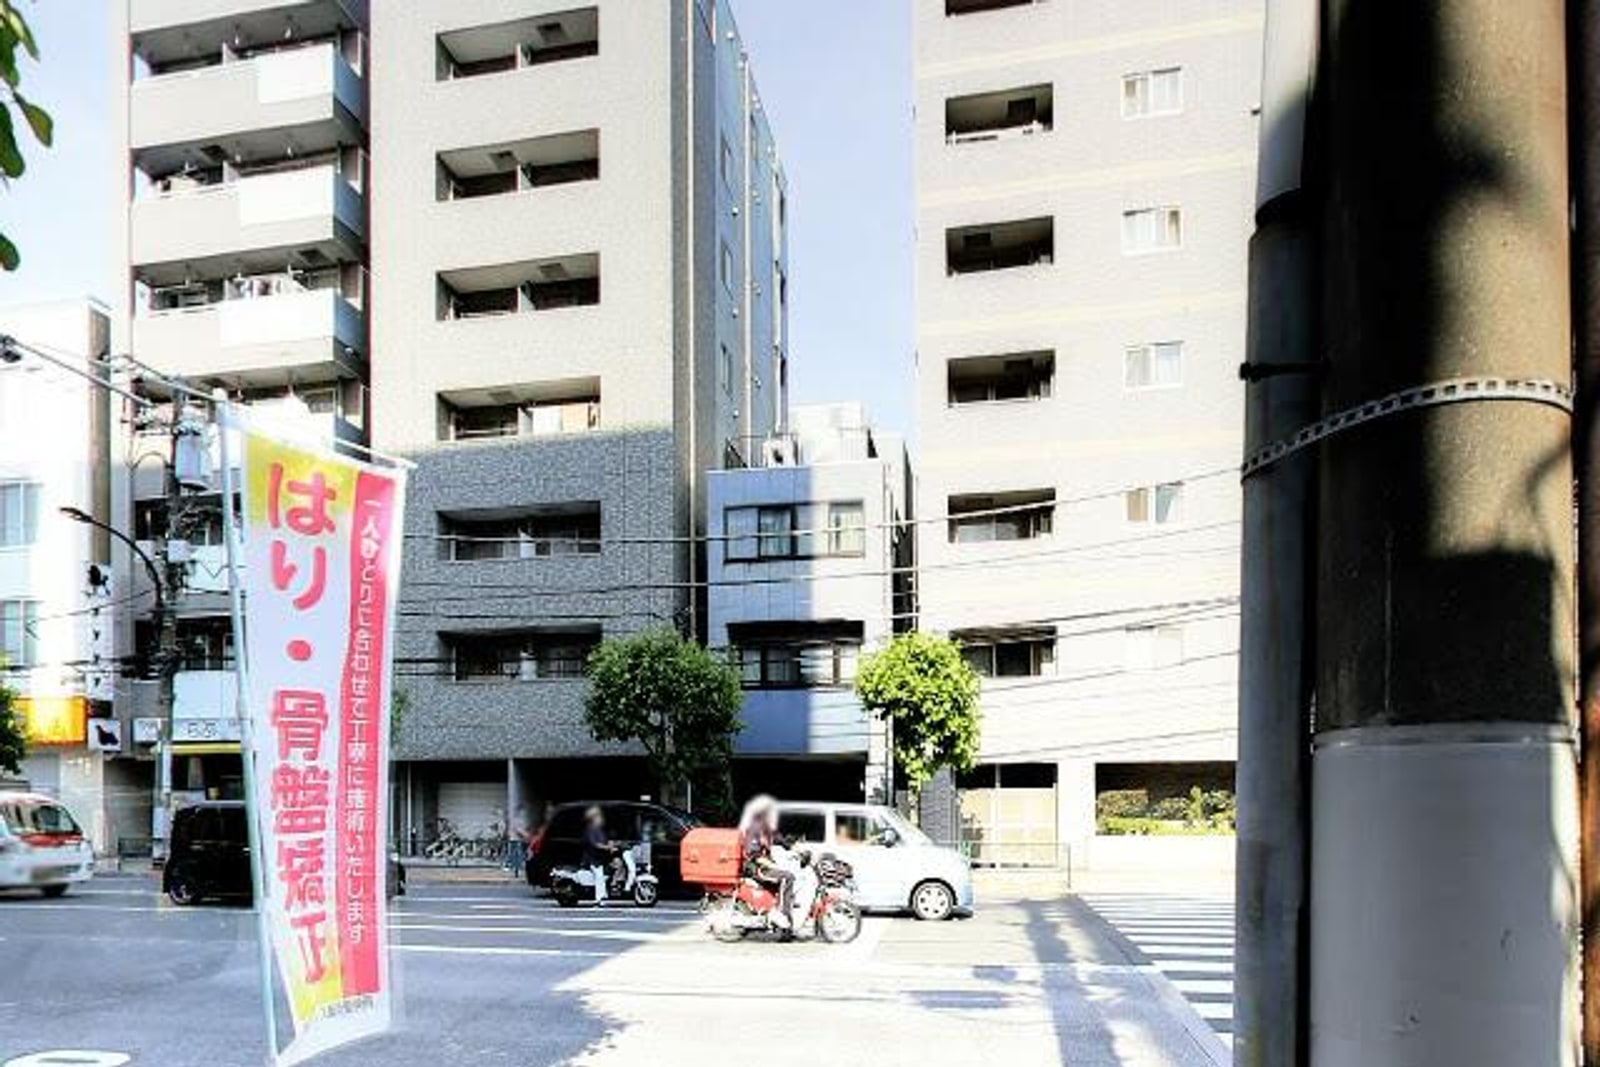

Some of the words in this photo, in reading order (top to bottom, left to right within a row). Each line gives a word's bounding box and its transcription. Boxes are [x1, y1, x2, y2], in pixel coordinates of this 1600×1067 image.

[268, 462, 336, 983] はり・骨盤矯正
